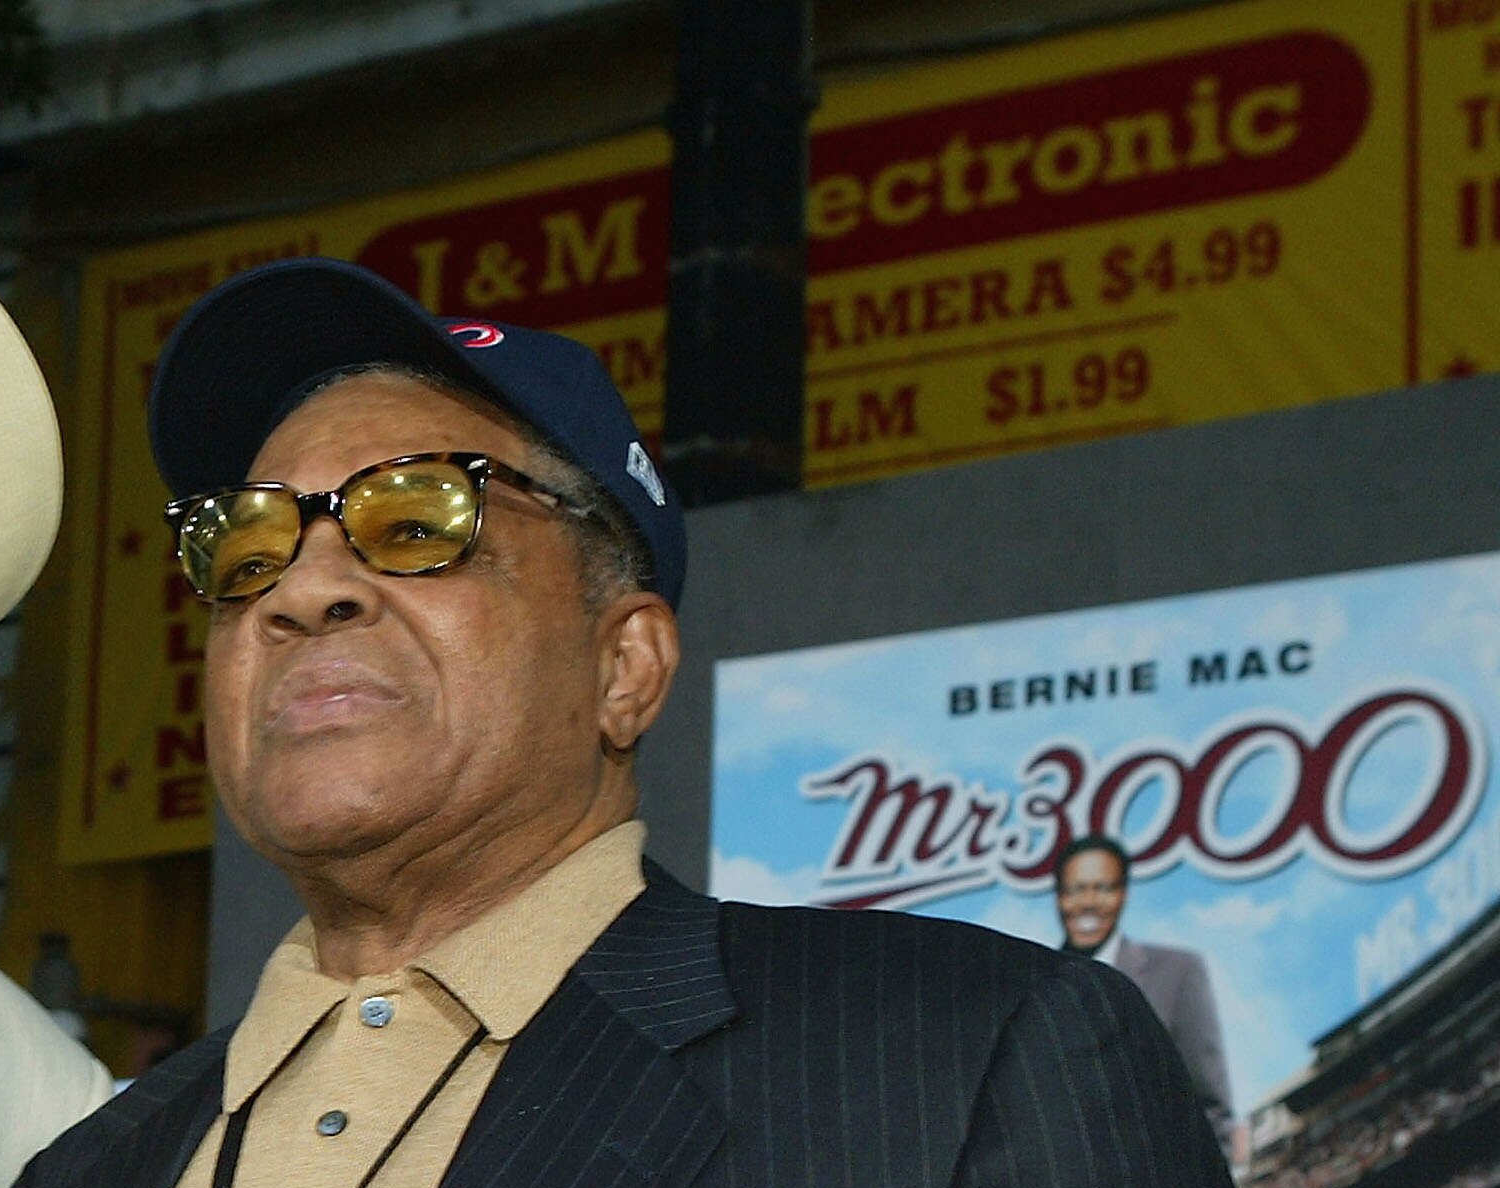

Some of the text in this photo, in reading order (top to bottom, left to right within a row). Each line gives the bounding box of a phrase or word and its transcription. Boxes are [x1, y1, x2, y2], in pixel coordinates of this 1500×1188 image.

[806, 77, 1303, 240] ectronic
[804, 220, 1285, 353] AMERA $4.99
[813, 347, 1152, 452] LM $1.99
[948, 639, 1316, 718] BERNIE MAC
